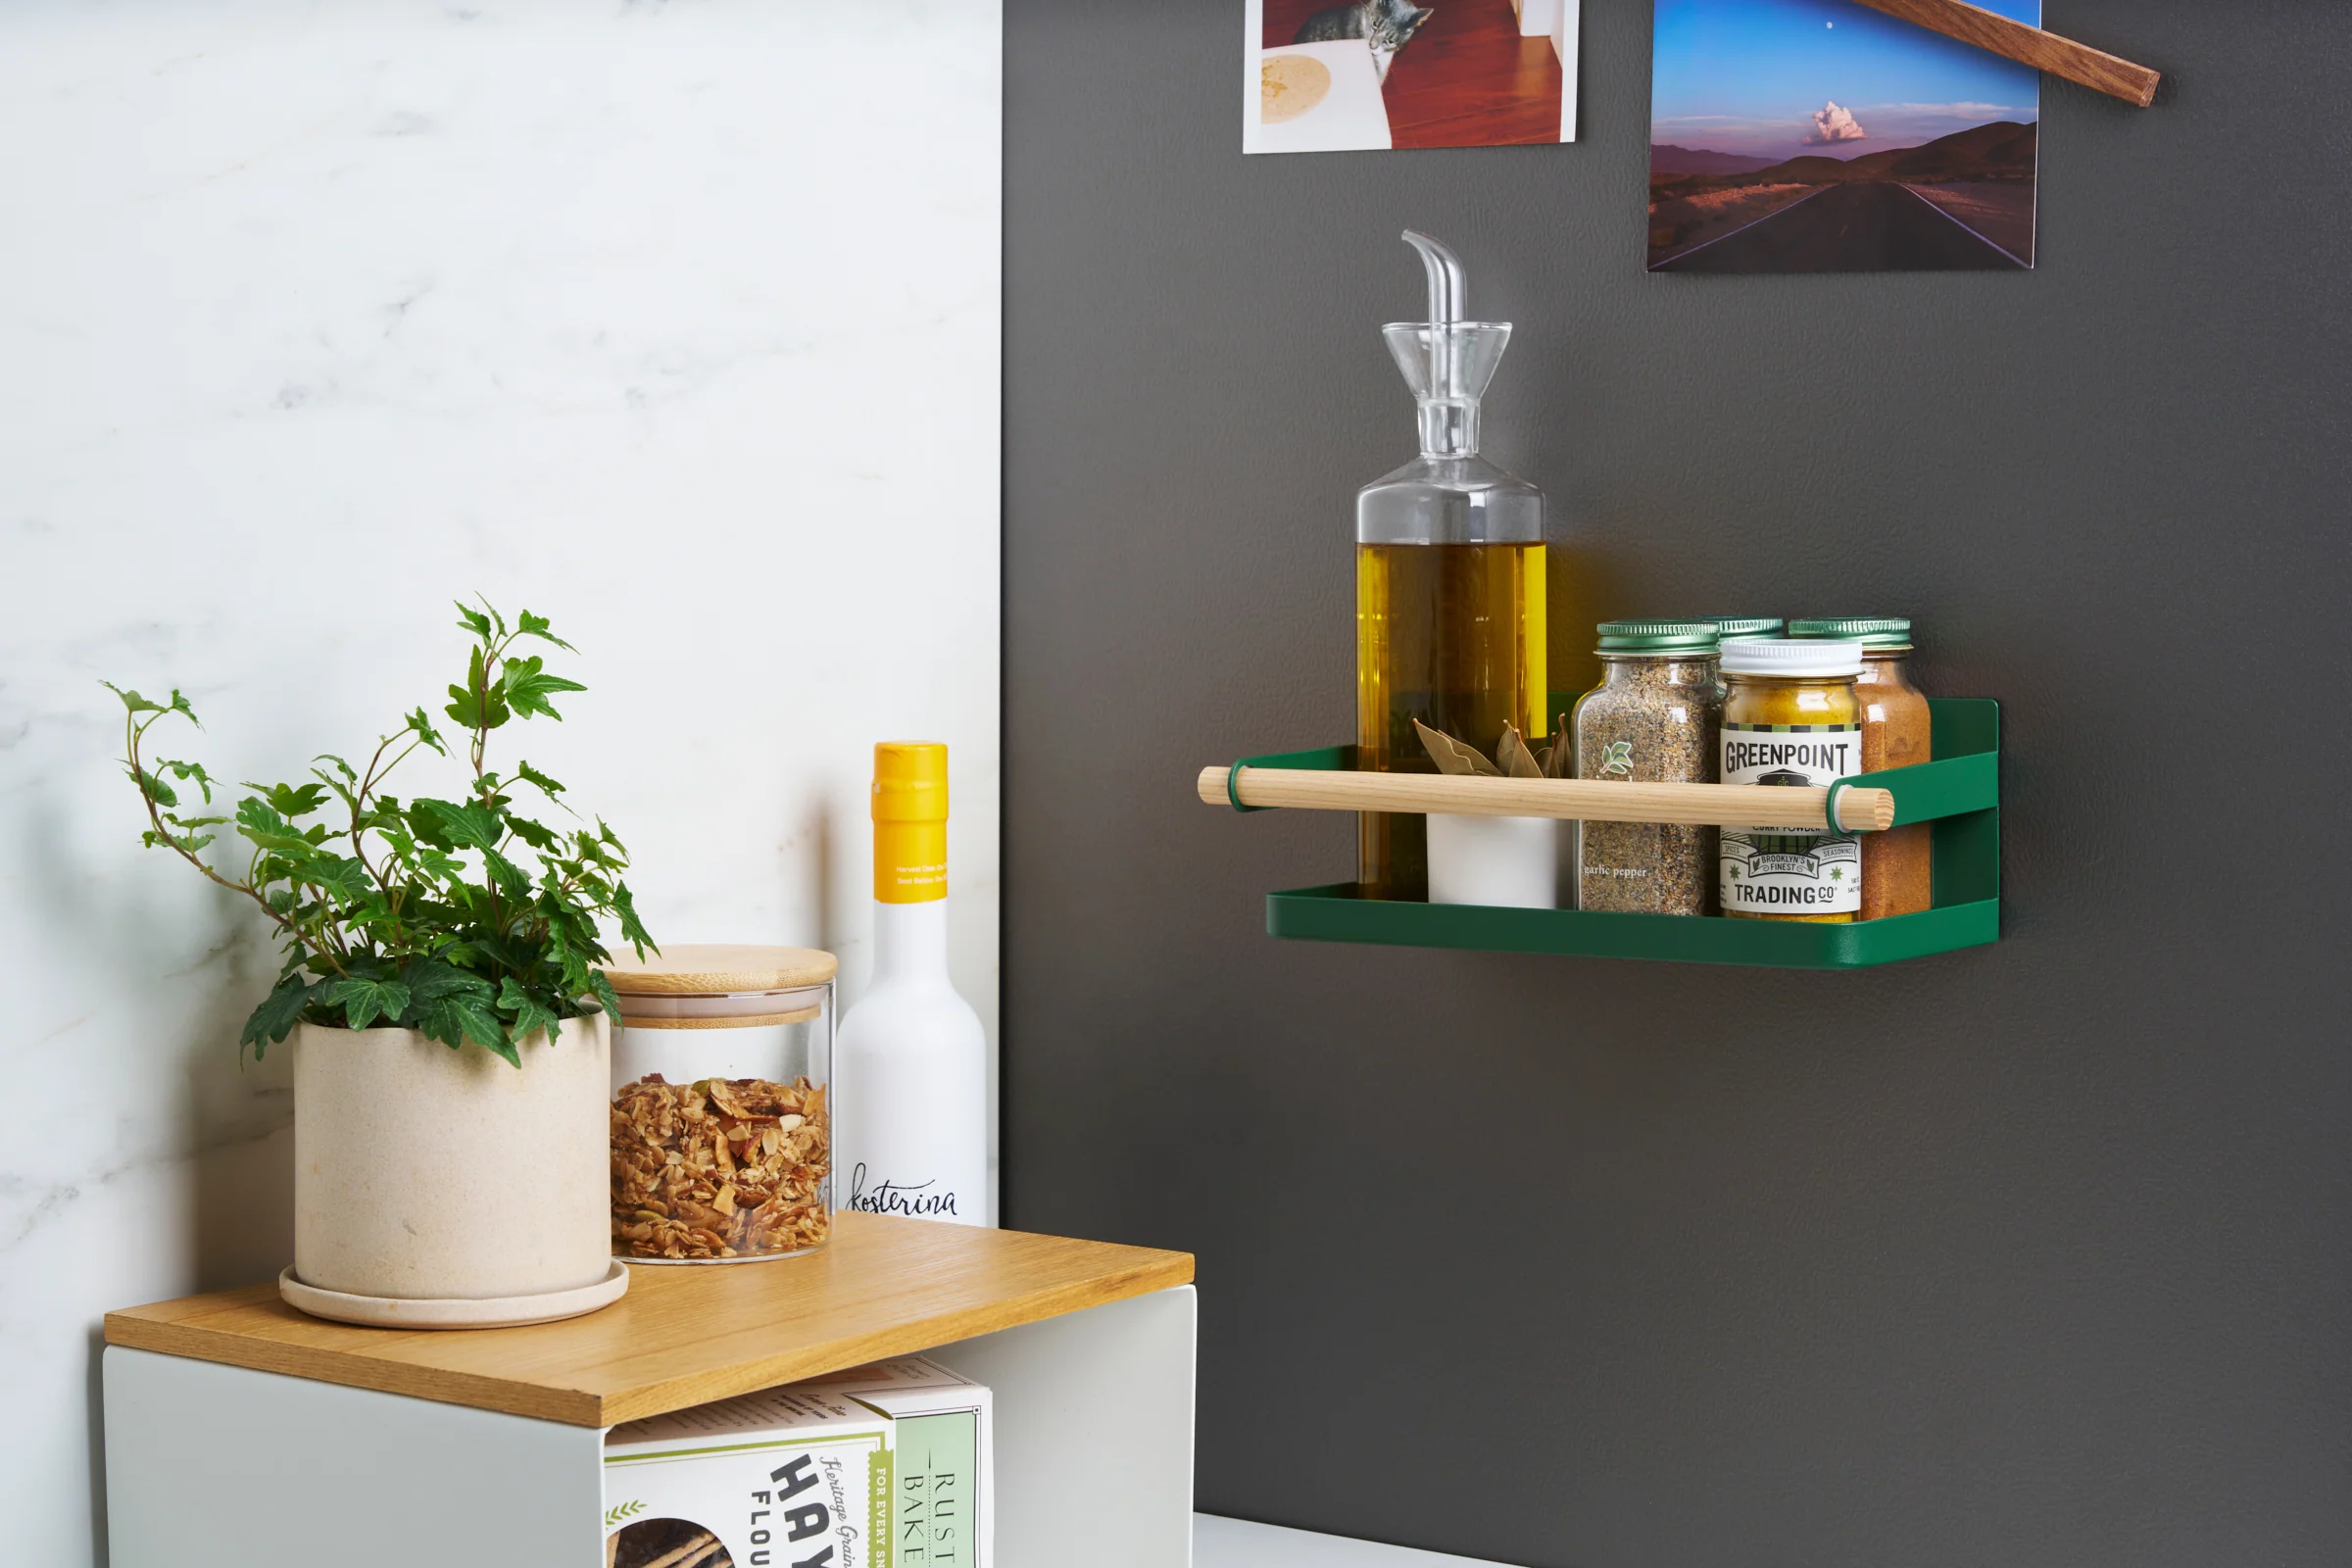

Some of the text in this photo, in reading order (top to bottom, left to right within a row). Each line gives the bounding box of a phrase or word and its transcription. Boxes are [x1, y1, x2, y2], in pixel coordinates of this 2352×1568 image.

[1726, 741, 1848, 776] GREENPOINT
[1584, 864, 1647, 879] garlic pepper
[1761, 855, 1806, 864] BROOKLYN'S
[1735, 884, 1816, 905] TRADING
[846, 1162, 957, 1215] kosterina
[819, 1456, 848, 1522] Heritage
[876, 1468, 886, 1496] FOR
[750, 1491, 771, 1566] FLOU
[876, 1500, 886, 1545] EVERY
[904, 1475, 924, 1563] BAKE
[935, 1473, 955, 1564] RUST
